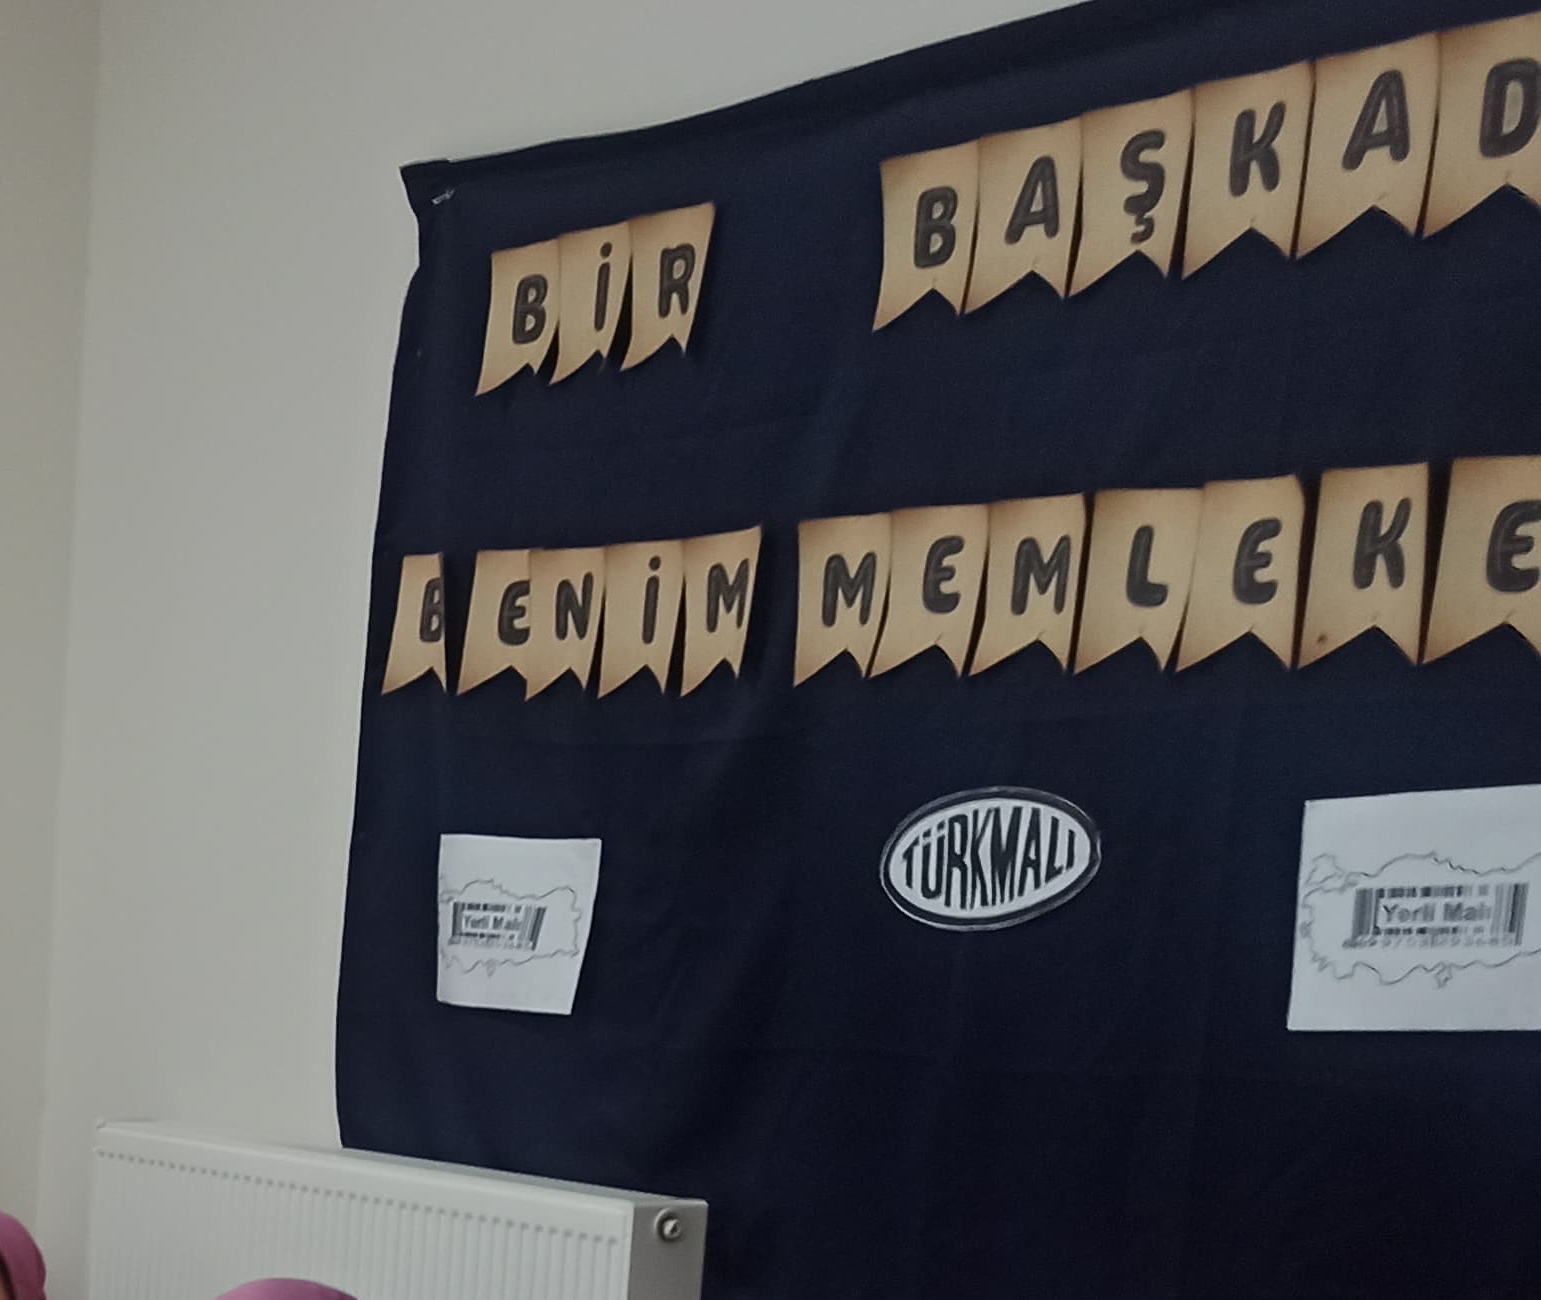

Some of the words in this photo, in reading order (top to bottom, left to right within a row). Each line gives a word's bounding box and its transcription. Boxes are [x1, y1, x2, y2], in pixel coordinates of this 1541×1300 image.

[512, 242, 696, 345] BİR
[914, 57, 1541, 269] BAŞKAD
[419, 556, 749, 646] BENİM
[823, 497, 1541, 630] MEMLEKE
[902, 805, 1075, 911] TÜRKMALI
